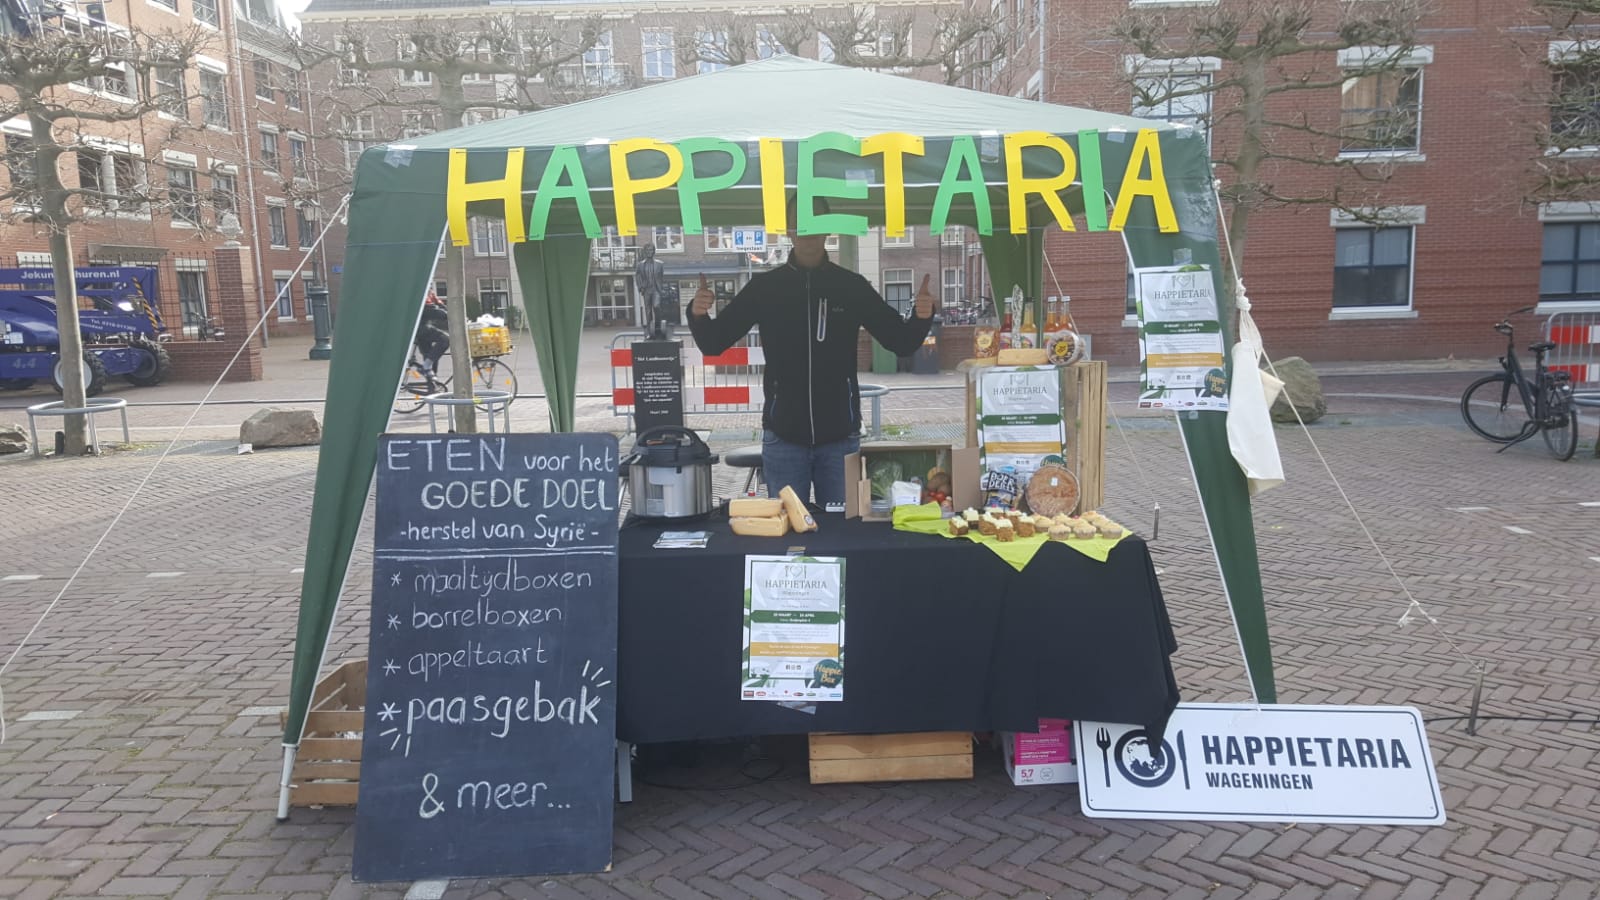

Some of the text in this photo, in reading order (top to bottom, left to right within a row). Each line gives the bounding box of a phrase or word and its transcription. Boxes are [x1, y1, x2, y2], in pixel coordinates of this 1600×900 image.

[447, 129, 1180, 246] HAPPIETARIA
[387, 437, 614, 473] ETEN voor het
[421, 478, 614, 511] GOEDE DOEL
[482, 523, 524, 539] van
[765, 579, 827, 590] HAPPIETARIA
[412, 598, 562, 629] borrelboxen
[408, 635, 548, 682] appeltaart
[406, 680, 600, 738] paasgebak
[1201, 735, 1413, 769] HAPPIETARIA
[419, 773, 445, 819] &
[1205, 772, 1314, 790] WAGENINGEN
